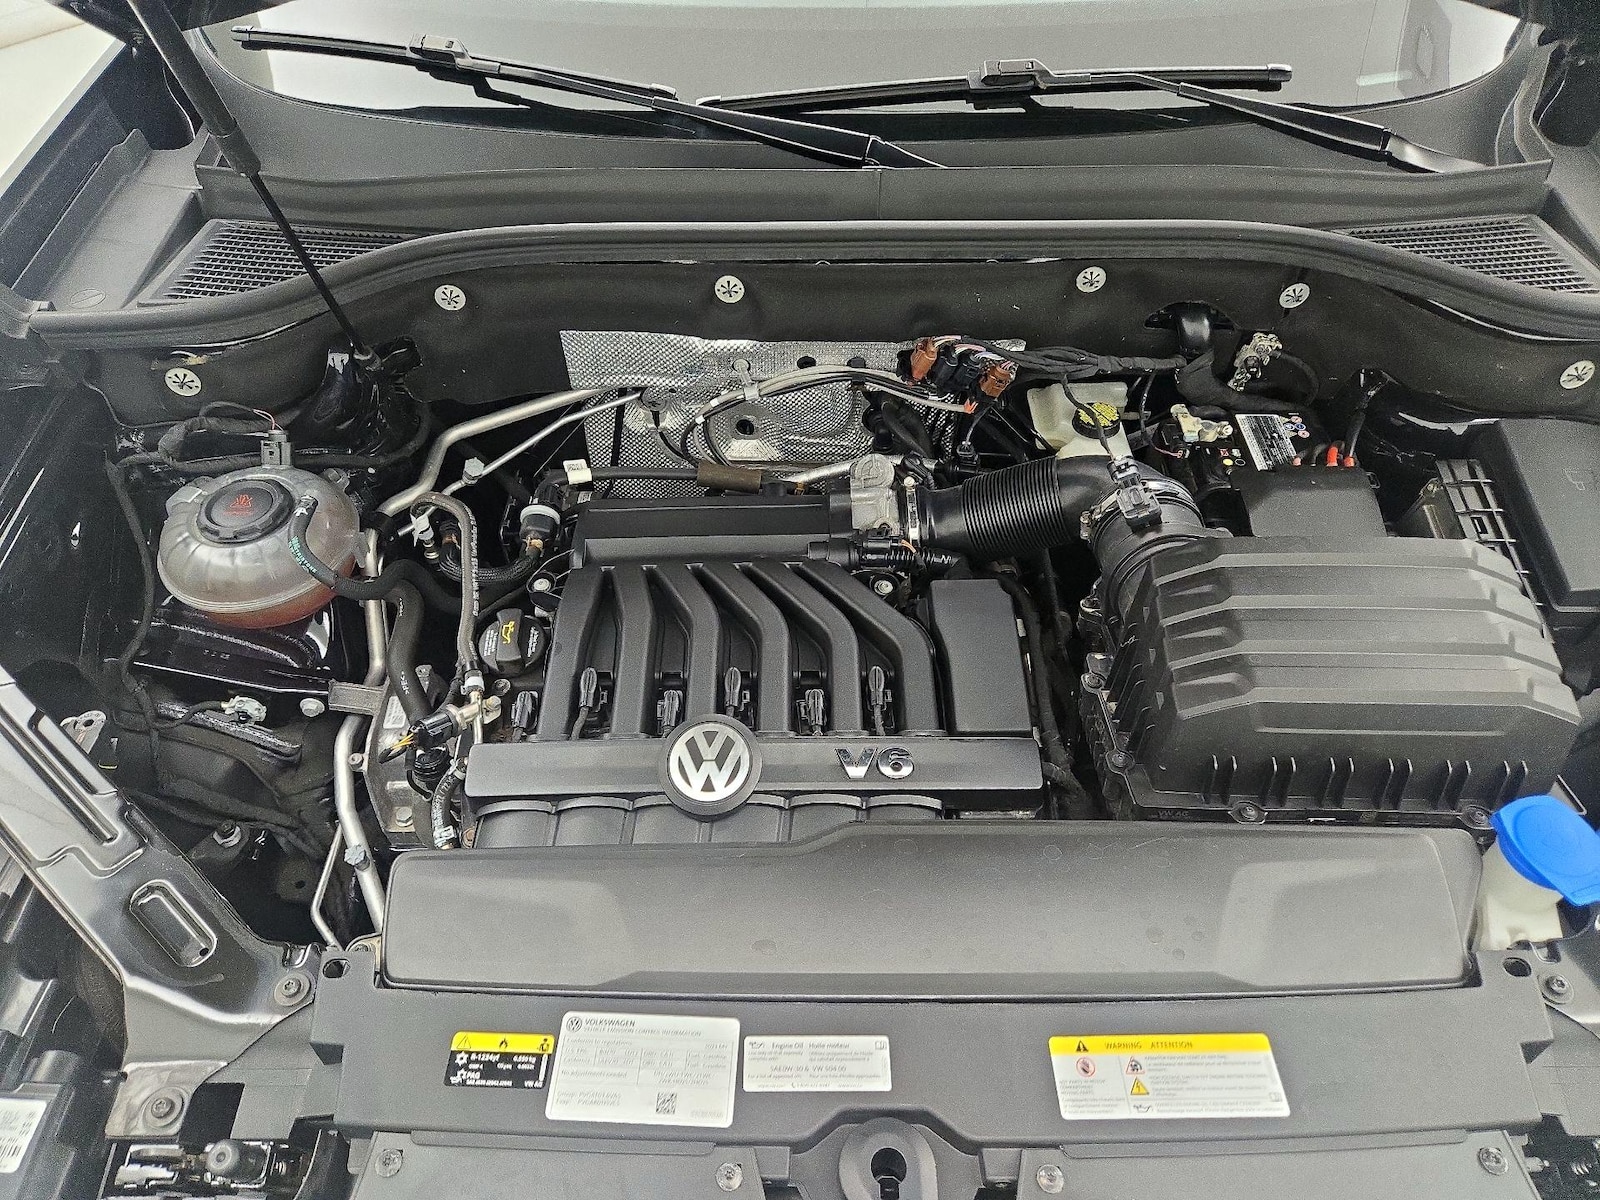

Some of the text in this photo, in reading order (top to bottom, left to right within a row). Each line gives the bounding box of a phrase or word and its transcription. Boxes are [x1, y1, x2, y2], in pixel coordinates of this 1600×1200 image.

[668, 721, 751, 804] VW
[835, 746, 915, 780] V6
[584, 1018, 636, 1028] VOLKSWAGEN
[772, 1041, 804, 1050] Engine Oil
[1105, 1040, 1193, 1050] WARNING ATTENTION
